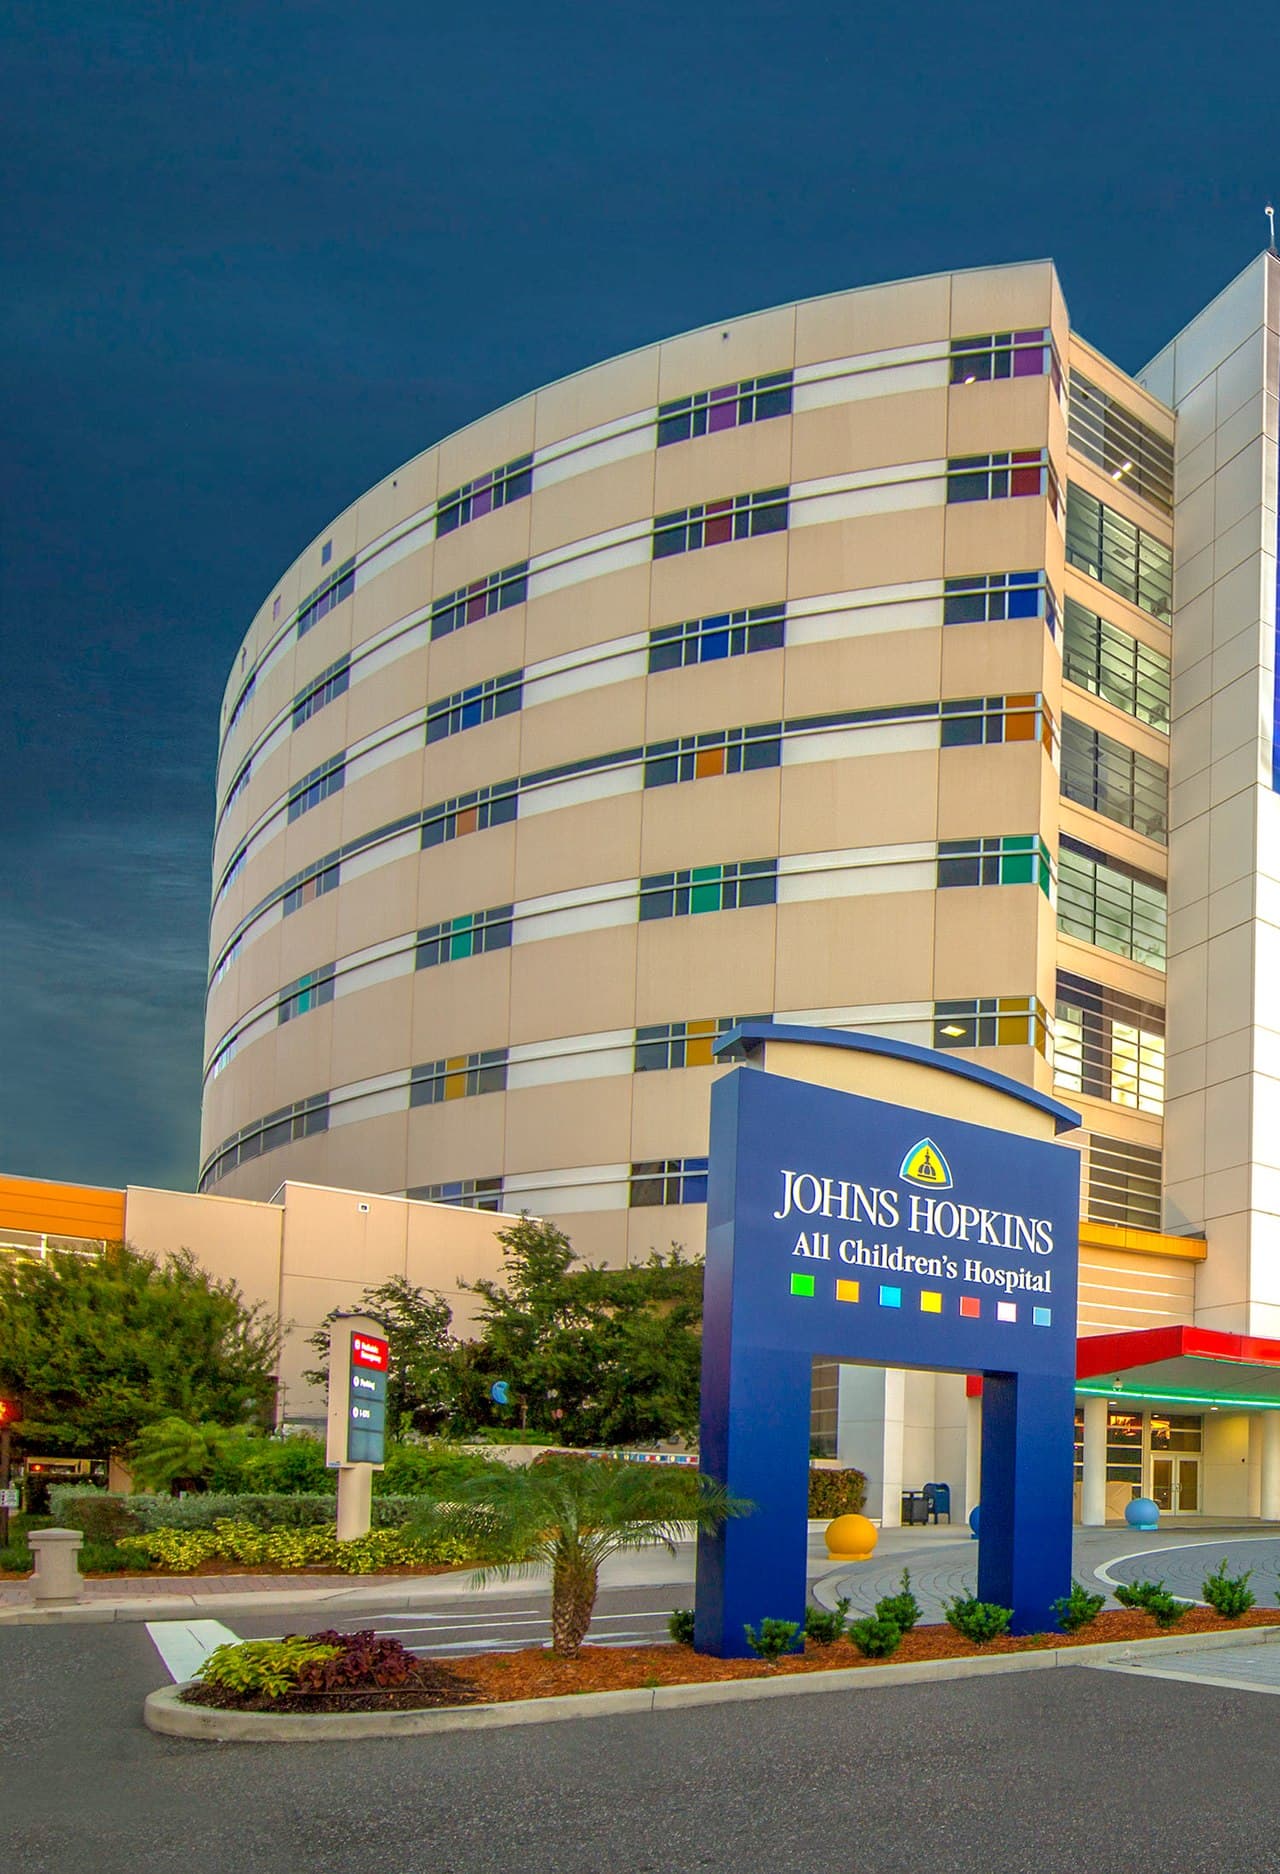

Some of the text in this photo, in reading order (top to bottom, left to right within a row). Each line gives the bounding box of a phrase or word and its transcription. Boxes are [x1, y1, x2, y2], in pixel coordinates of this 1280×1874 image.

[773, 1169, 1055, 1255] JOHNS HOPKINS
[791, 1231, 1052, 1294] All Children's Hospital
